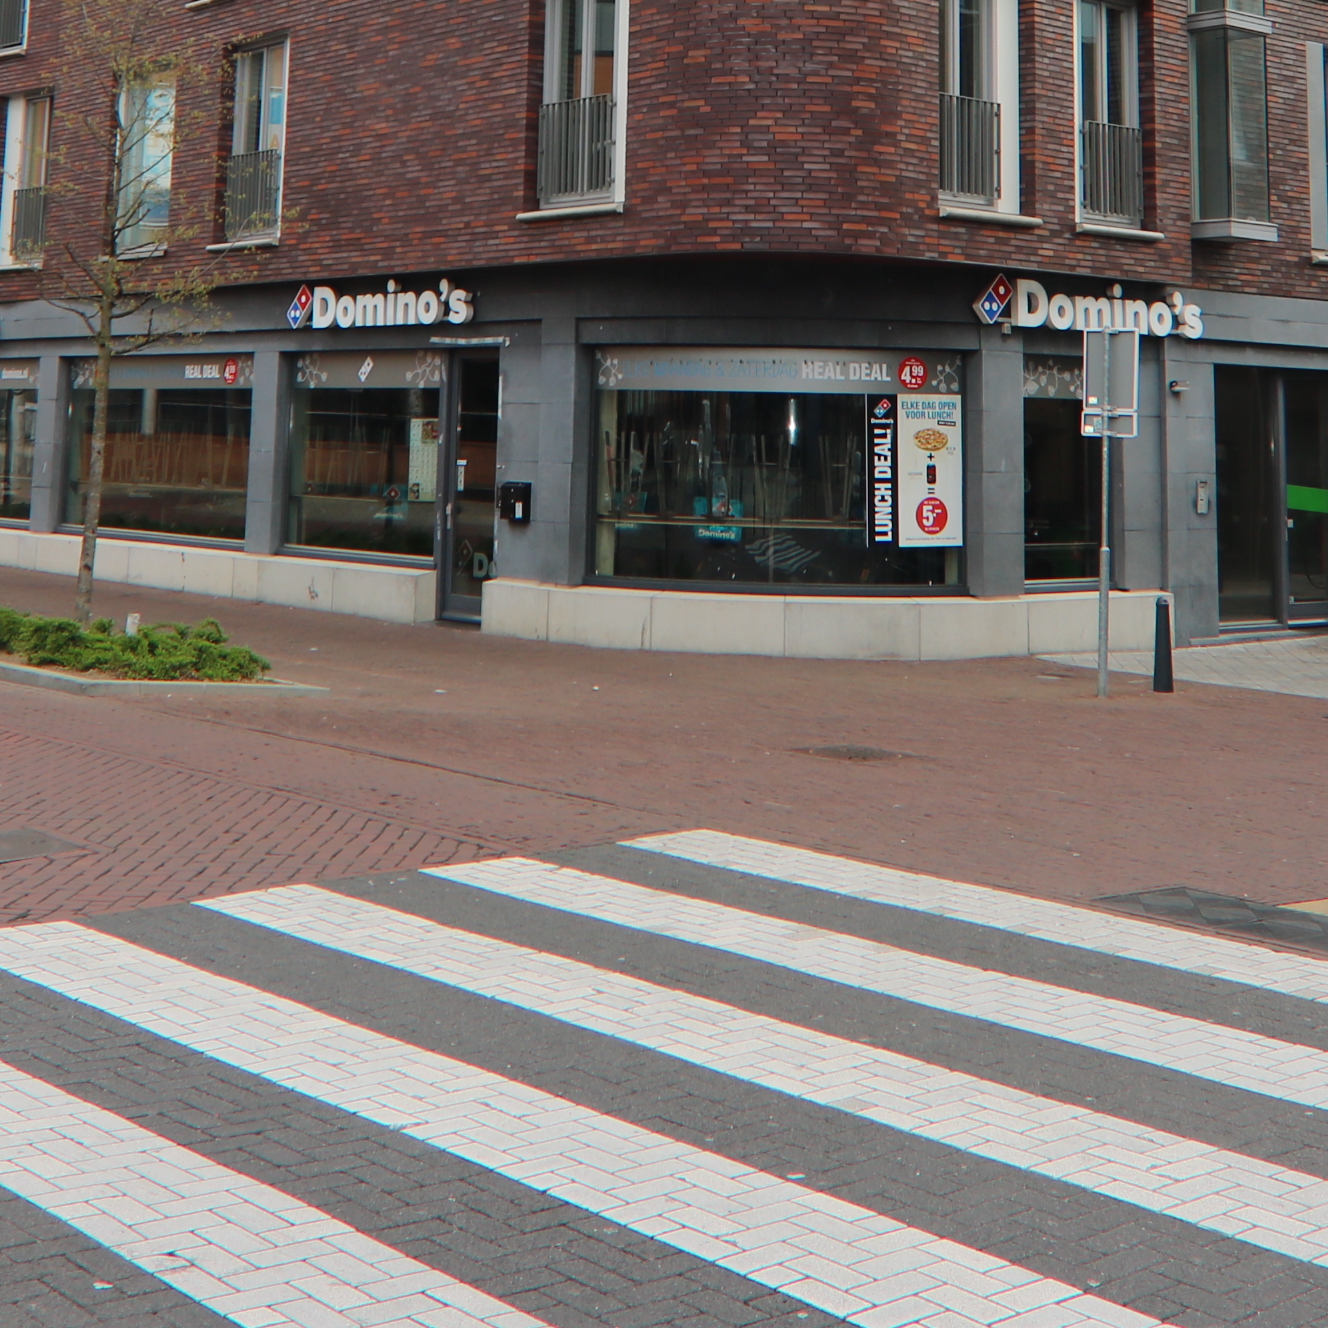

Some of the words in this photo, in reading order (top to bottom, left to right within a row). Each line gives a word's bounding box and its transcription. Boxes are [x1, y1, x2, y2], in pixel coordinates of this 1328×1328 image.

[312, 278, 473, 329] Domino's
[1012, 278, 1204, 339] Domino's
[184, 365, 201, 379] REAL
[203, 364, 220, 379] DEAL
[802, 361, 845, 380] REAL
[849, 363, 892, 382] DEAL
[901, 401, 920, 410] ELKE
[922, 401, 936, 410] DAG
[938, 401, 957, 411] OPEN
[905, 411, 926, 419] VOOR
[927, 411, 954, 420] LUNCH!
[874, 428, 892, 479] DEAL!
[874, 483, 892, 542] LUNCH
